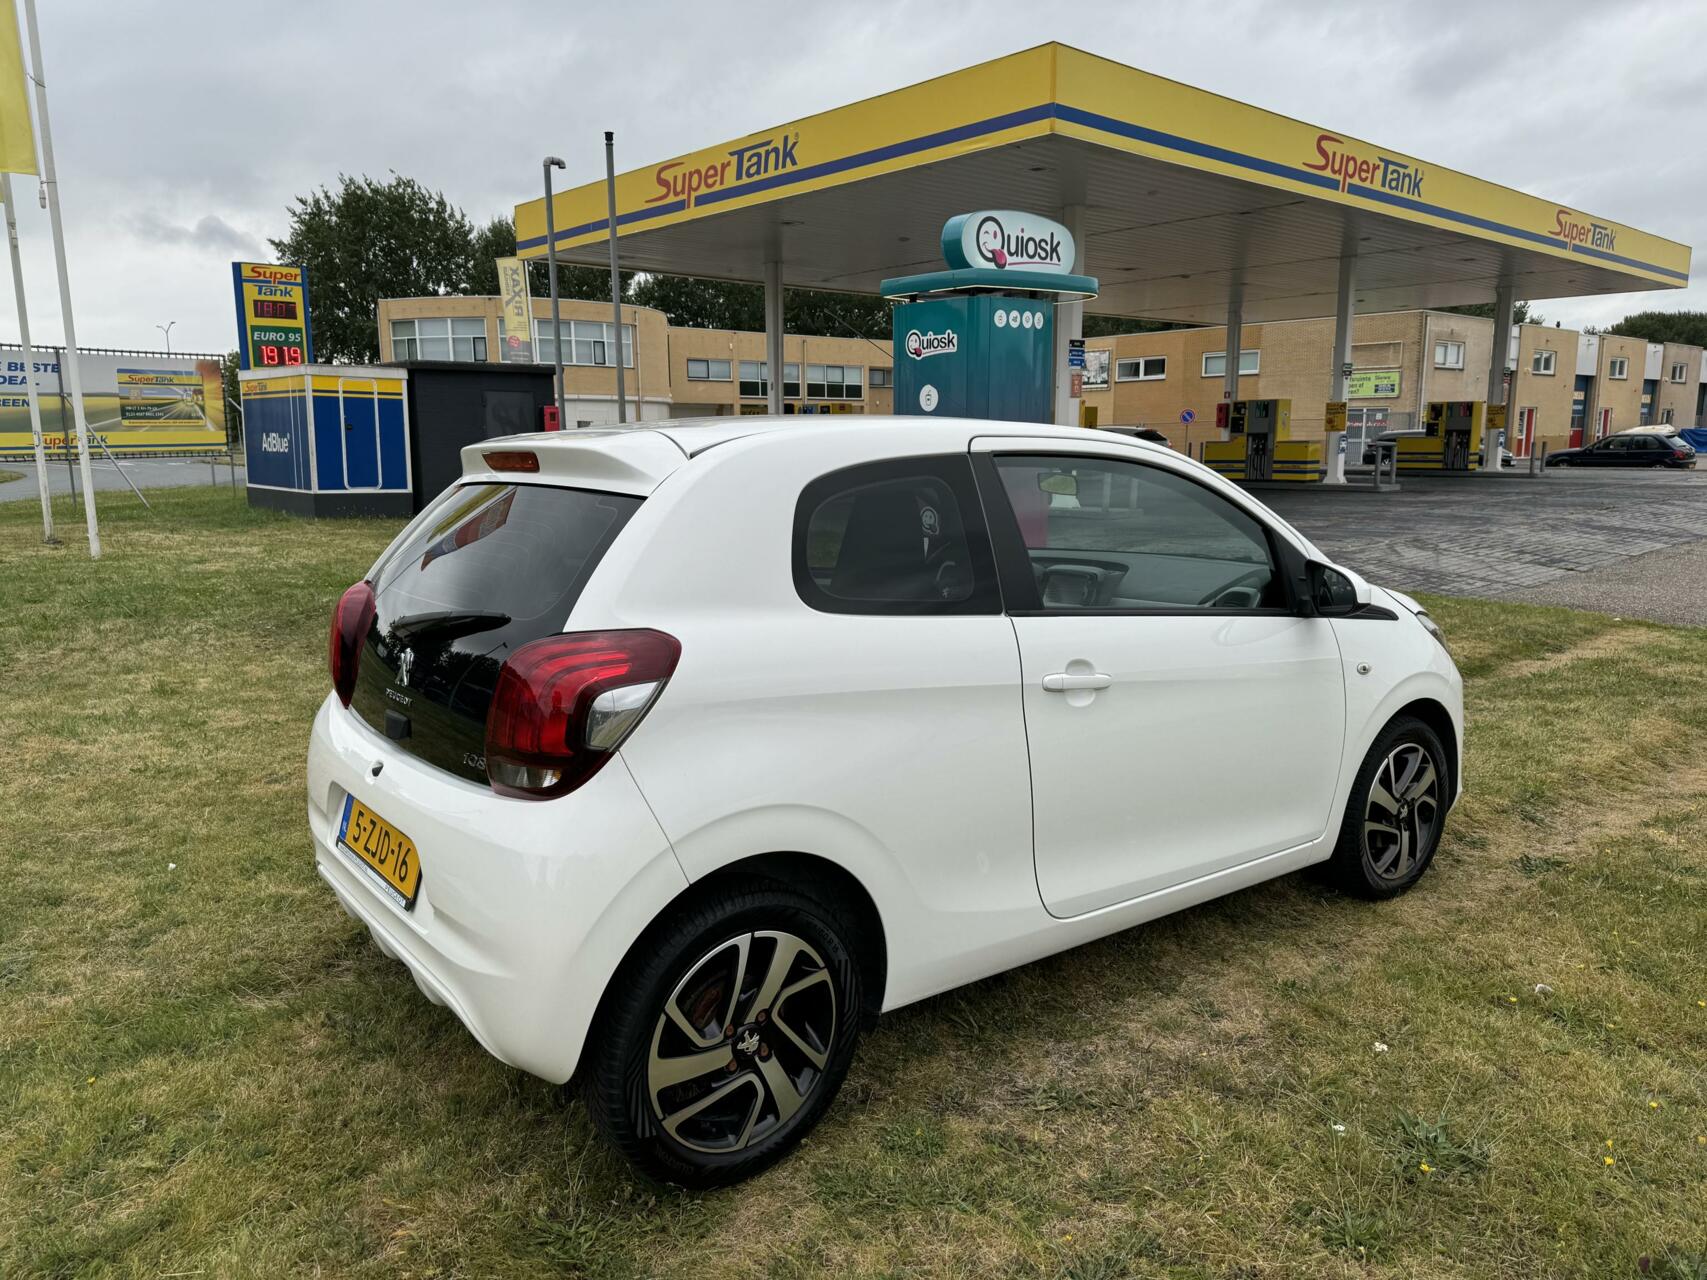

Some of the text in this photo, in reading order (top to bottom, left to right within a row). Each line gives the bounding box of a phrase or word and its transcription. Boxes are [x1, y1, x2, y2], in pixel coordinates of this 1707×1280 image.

[976, 216, 1062, 269] Quiosk
[243, 266, 300, 284] Super
[253, 285, 293, 297] Tank
[253, 331, 301, 342] EURO 95
[907, 331, 956, 357] Quiosk
[352, 809, 411, 883] 5-ZJD-16
